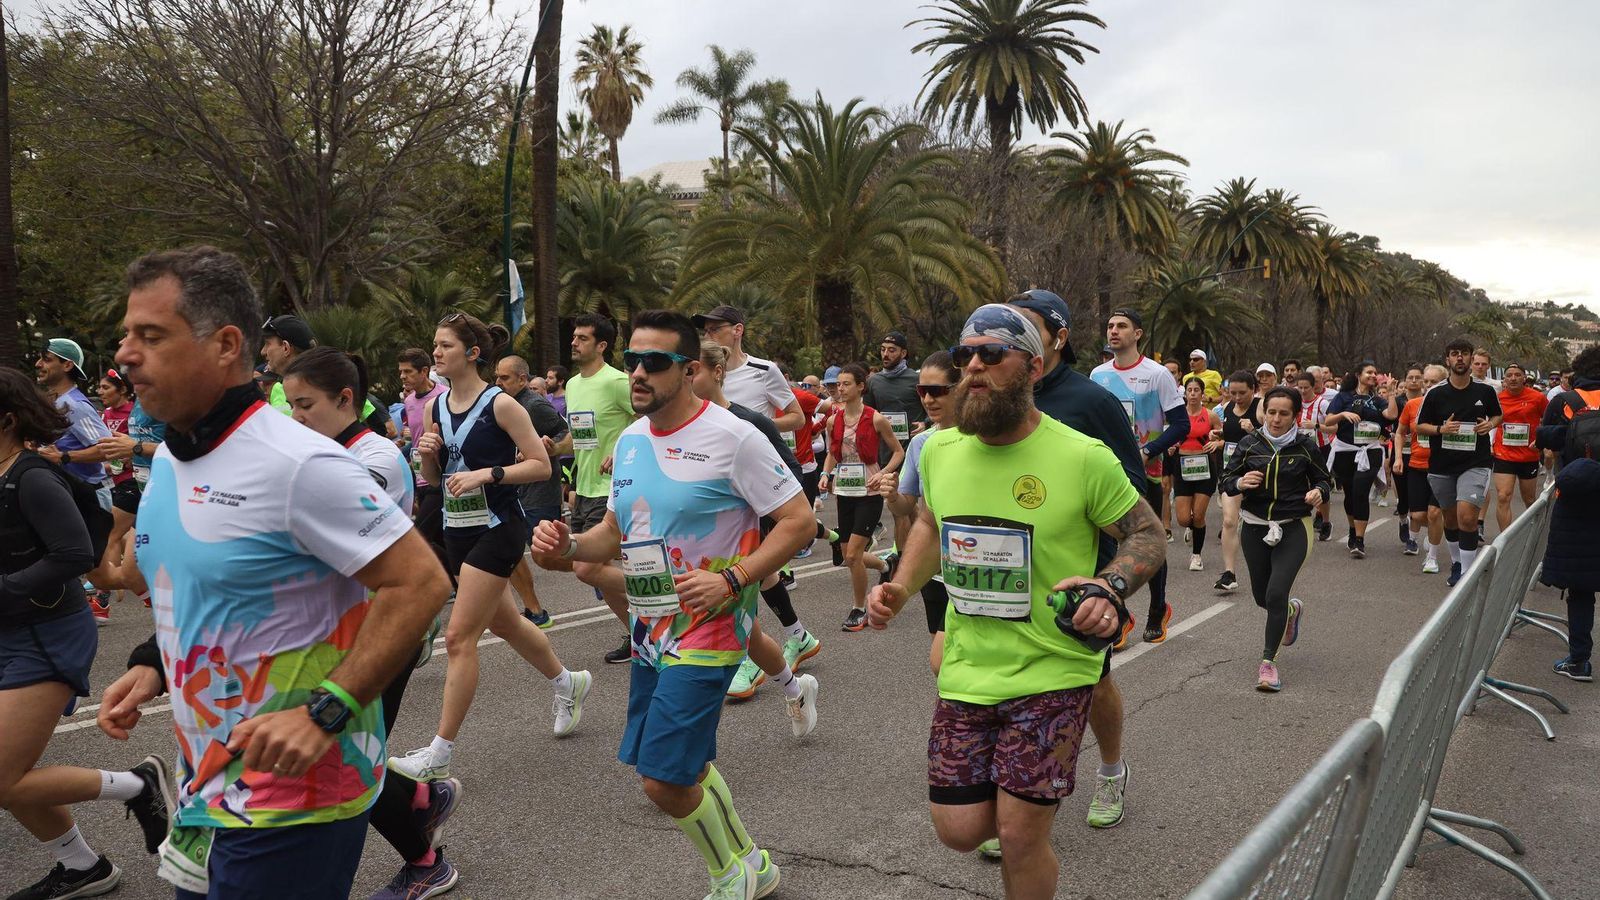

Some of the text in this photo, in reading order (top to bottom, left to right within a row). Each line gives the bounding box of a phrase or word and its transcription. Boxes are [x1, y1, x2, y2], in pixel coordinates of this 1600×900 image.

[841, 477, 861, 487] 5462
[625, 576, 662, 595] 4120
[956, 566, 1012, 590] 5117
